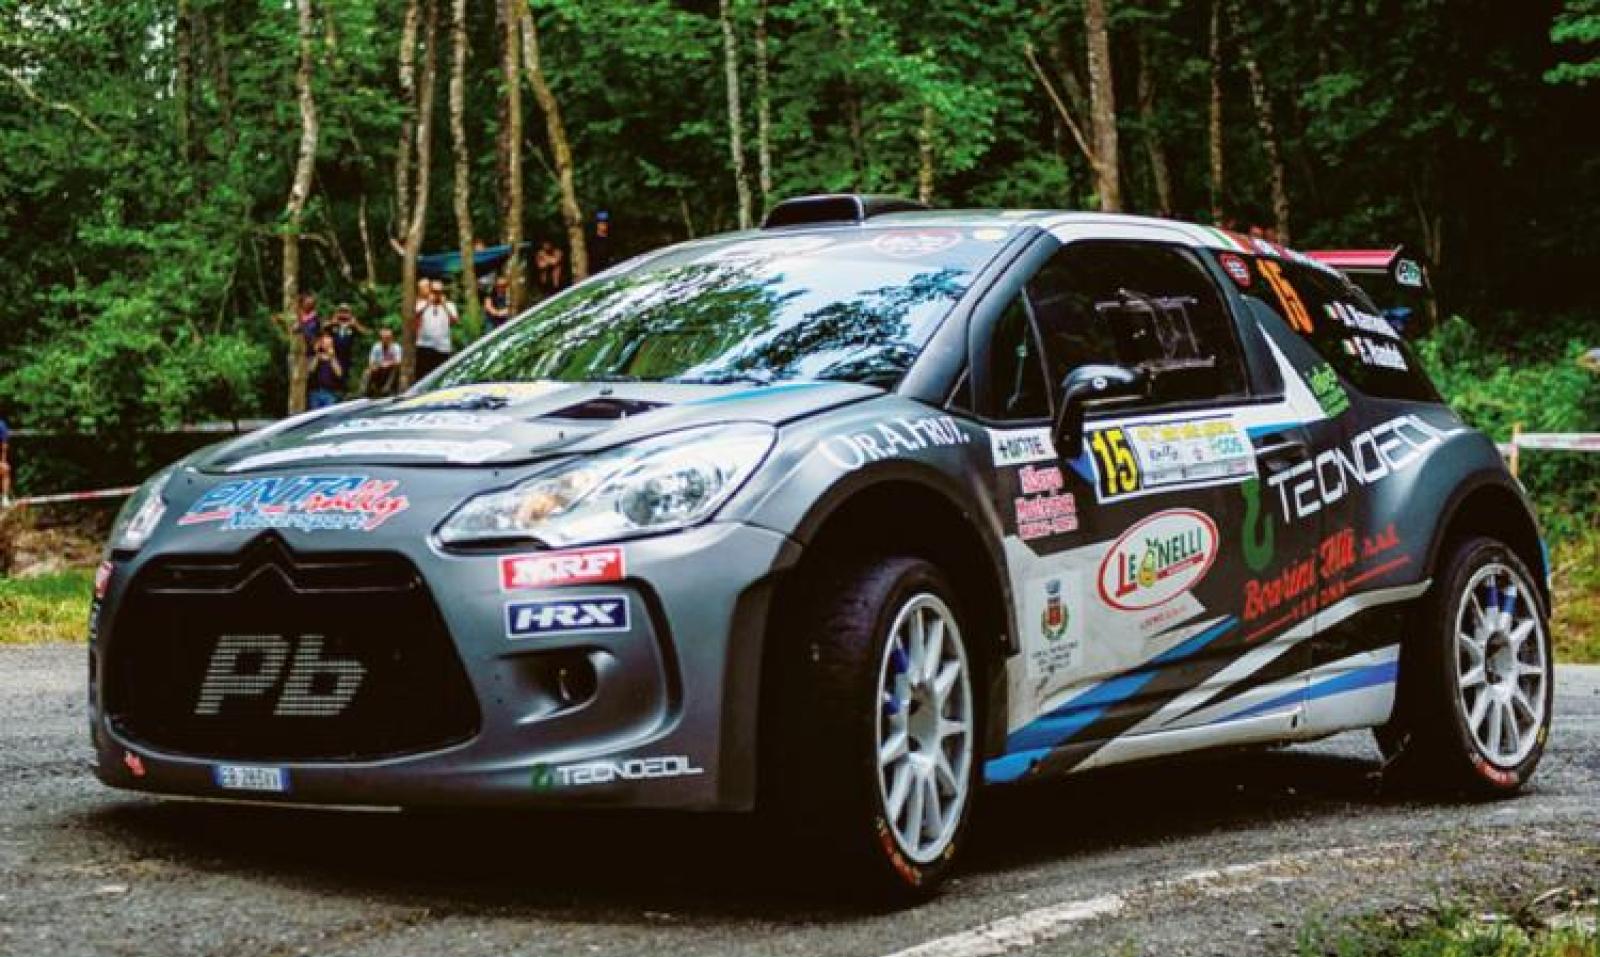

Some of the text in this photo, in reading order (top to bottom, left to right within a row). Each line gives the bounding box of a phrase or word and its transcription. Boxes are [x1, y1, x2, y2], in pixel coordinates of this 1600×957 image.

[1255, 257, 1314, 333] 15
[1092, 429, 1138, 495] 15
[511, 552, 617, 586] MRF
[515, 602, 620, 630] HRX
[194, 634, 367, 716] Pb
